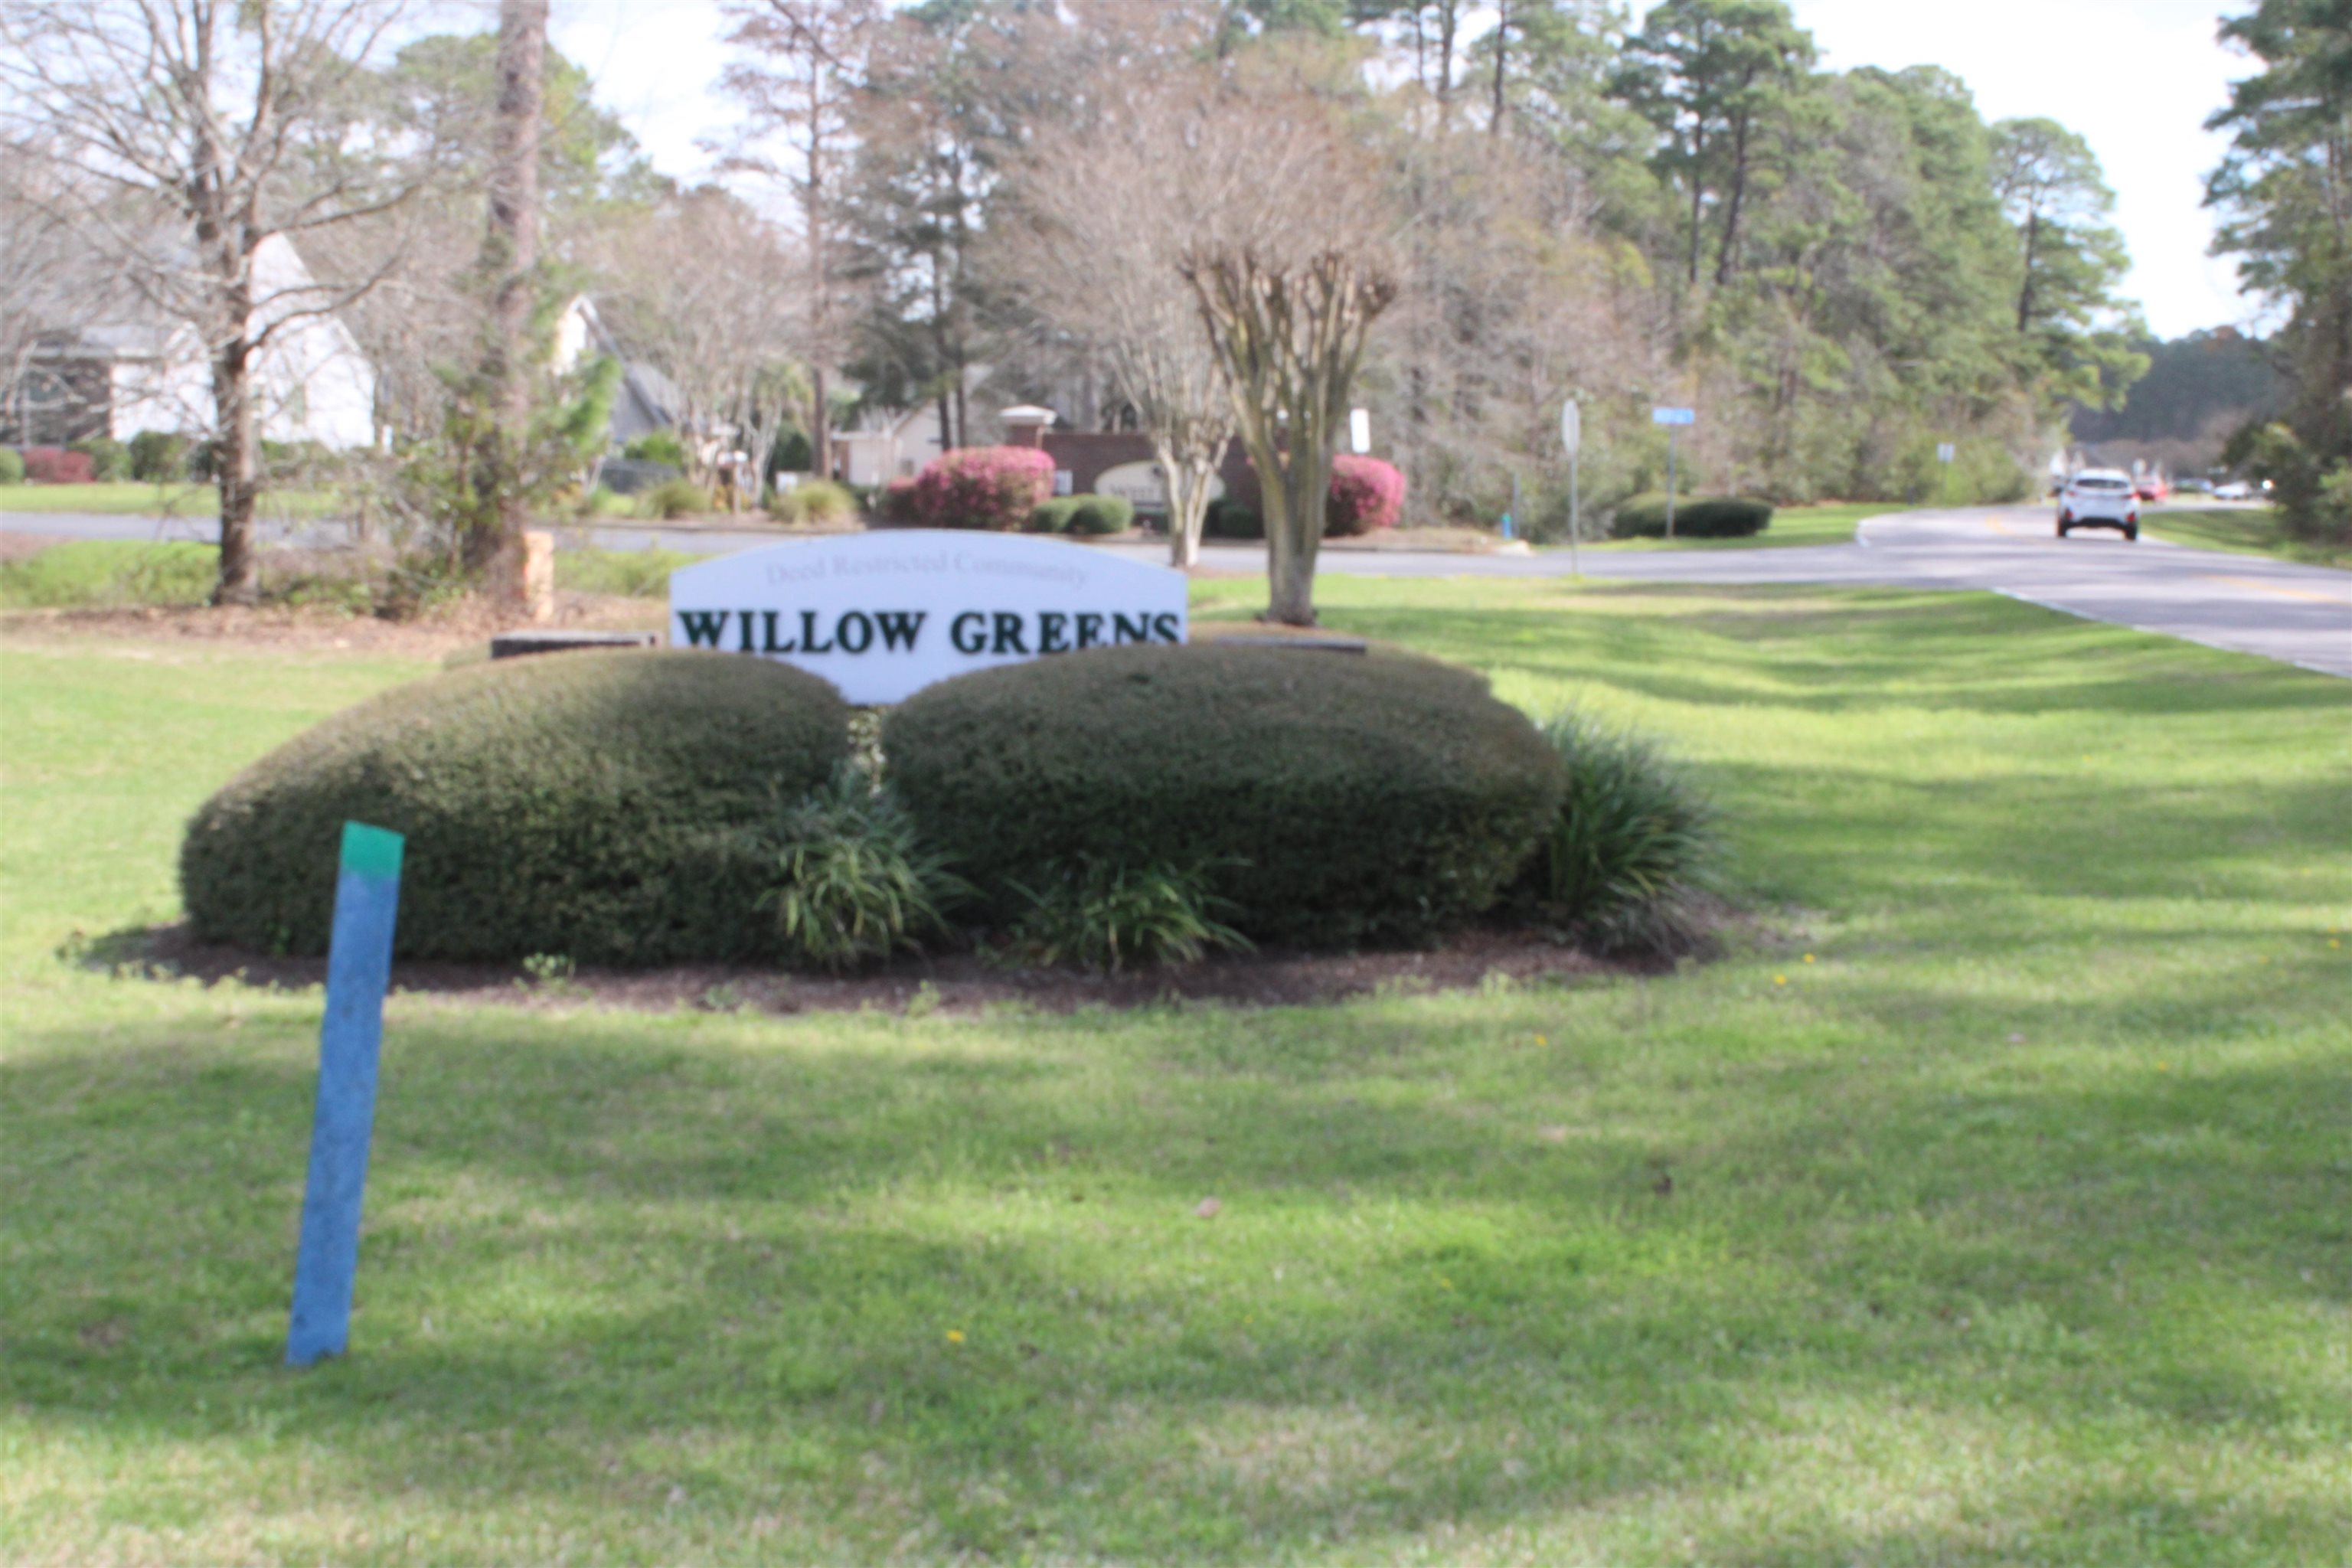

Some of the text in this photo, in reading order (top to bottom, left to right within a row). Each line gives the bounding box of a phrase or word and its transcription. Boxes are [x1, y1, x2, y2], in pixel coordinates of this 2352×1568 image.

[766, 550, 1088, 590] Deed Restricted Community
[677, 610, 1179, 655] WILLOW GREENS
